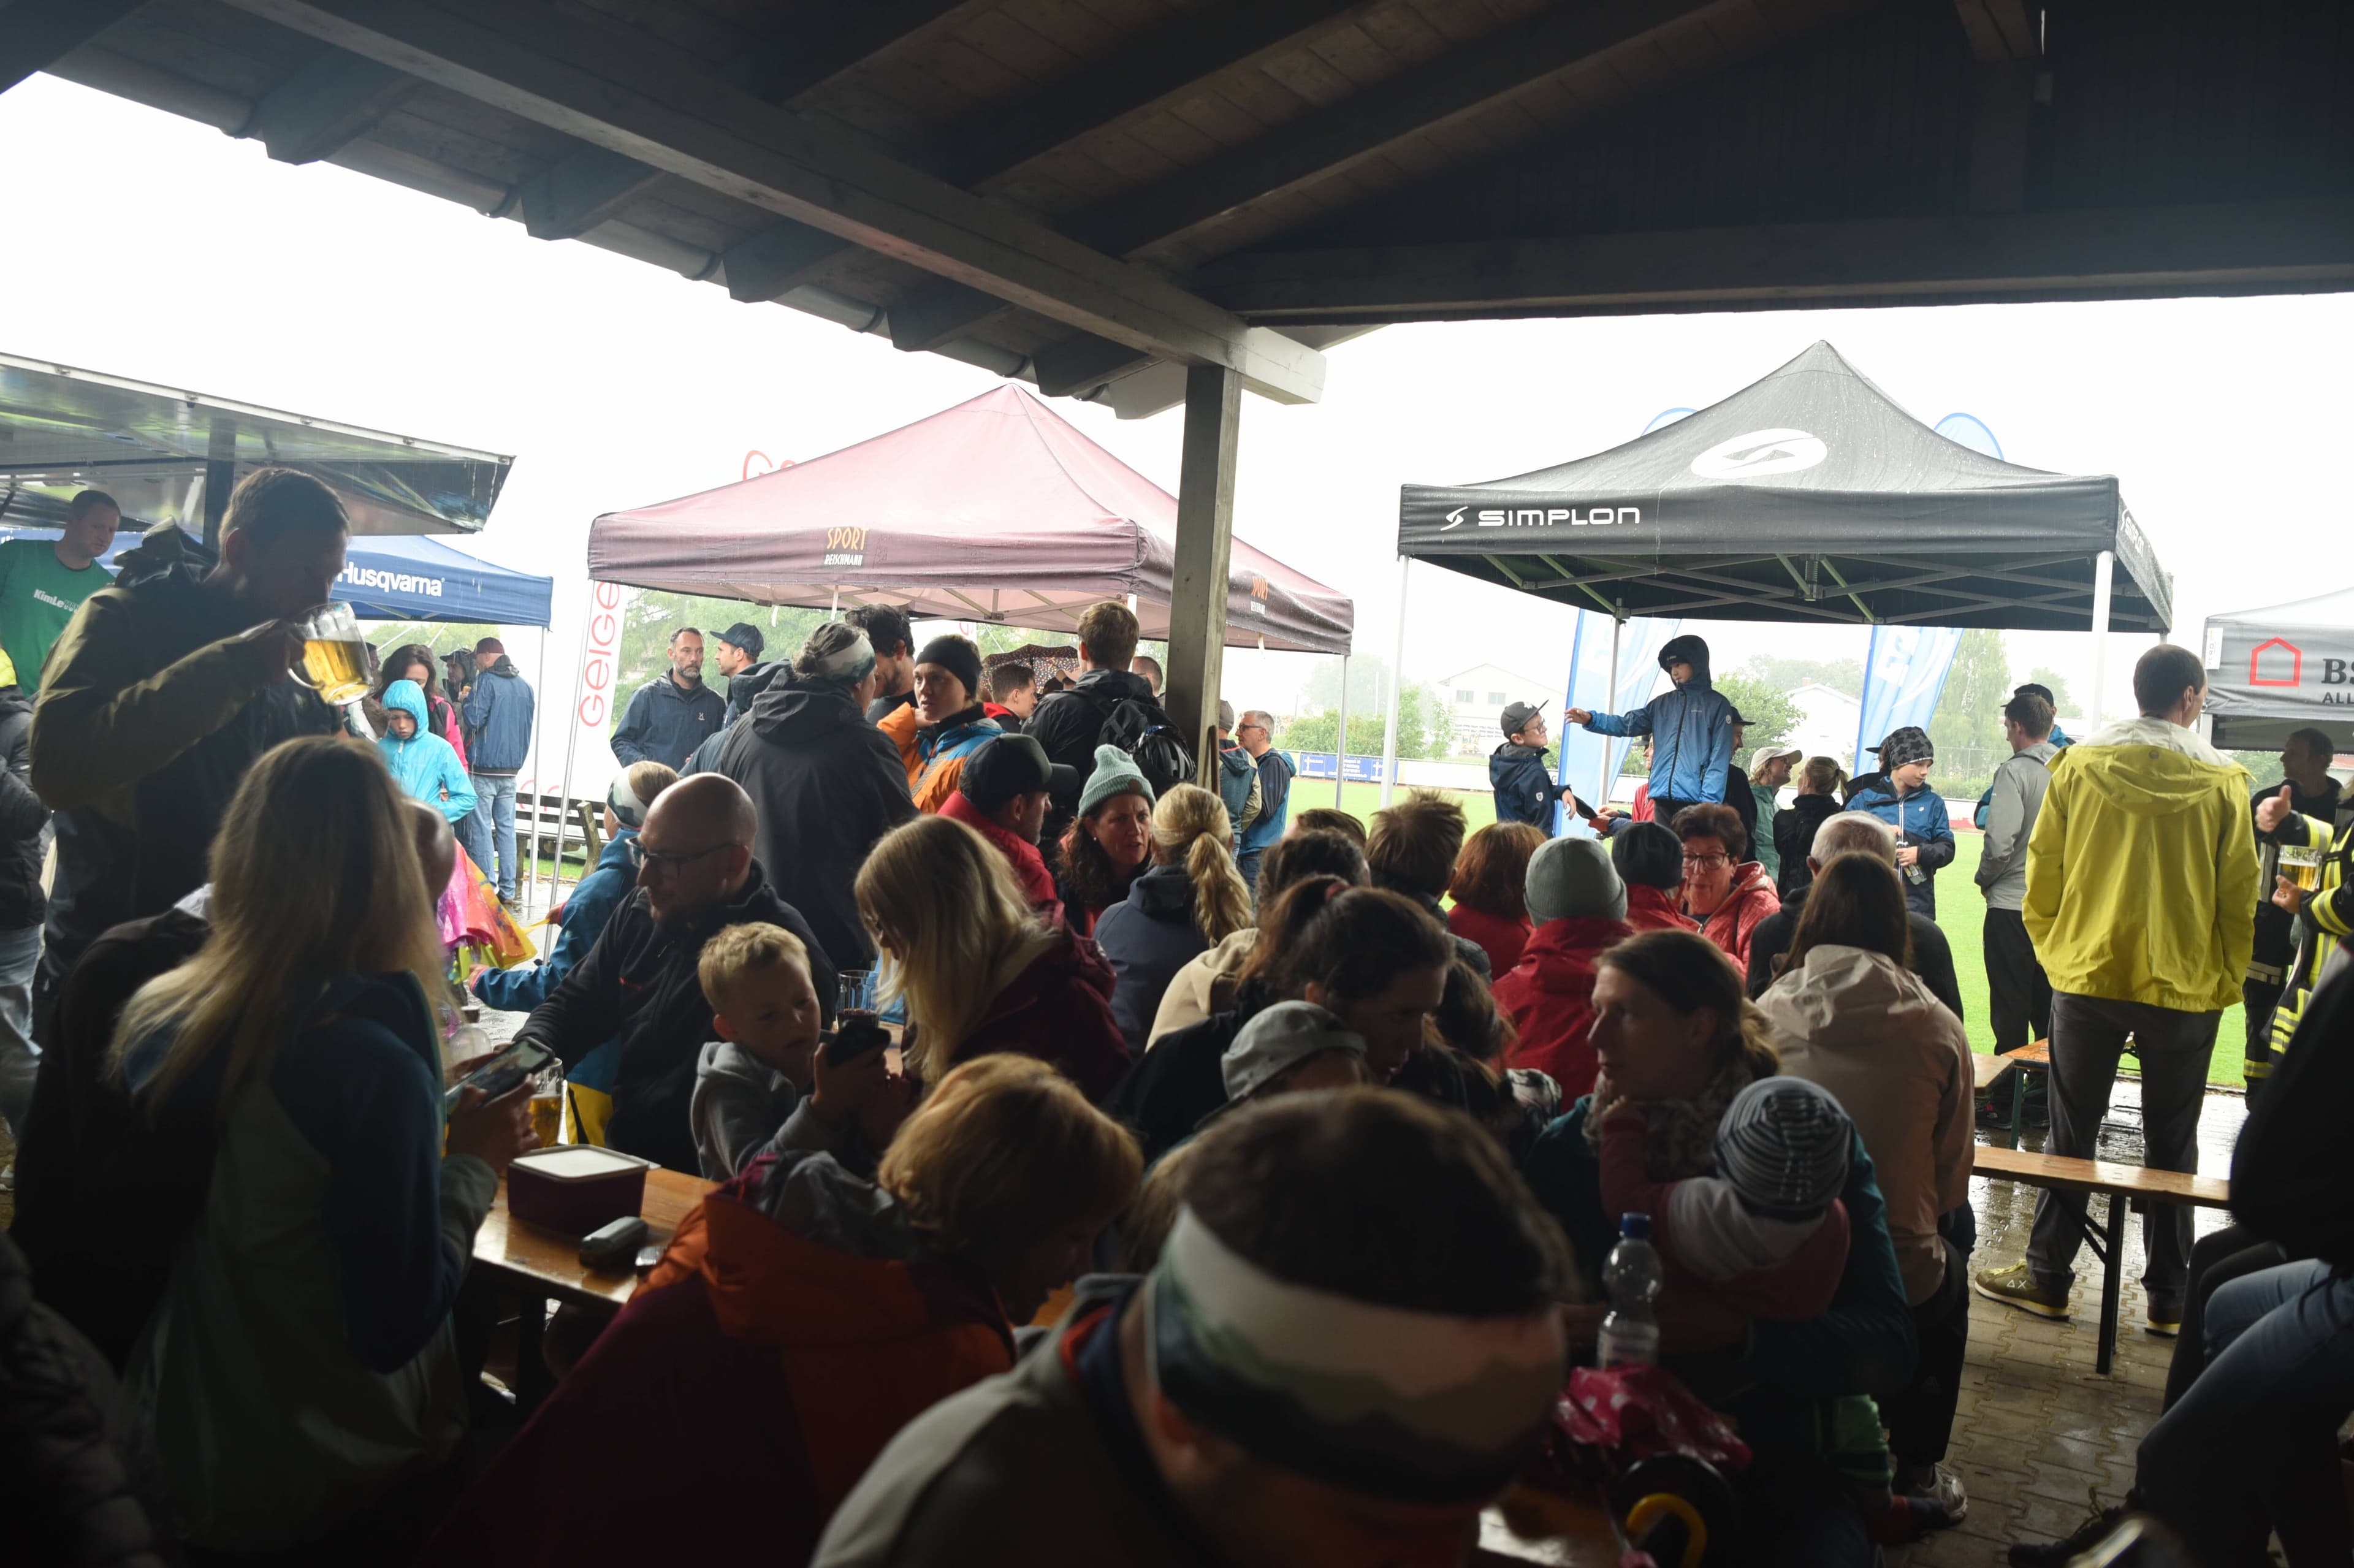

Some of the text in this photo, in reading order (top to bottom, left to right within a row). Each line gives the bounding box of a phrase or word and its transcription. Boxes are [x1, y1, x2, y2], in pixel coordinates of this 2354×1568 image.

[1478, 508, 1640, 527] SIMPLON
[826, 527, 869, 550] SPORT
[824, 553, 863, 566] REISCHMANN
[337, 561, 443, 597] Husqvarna
